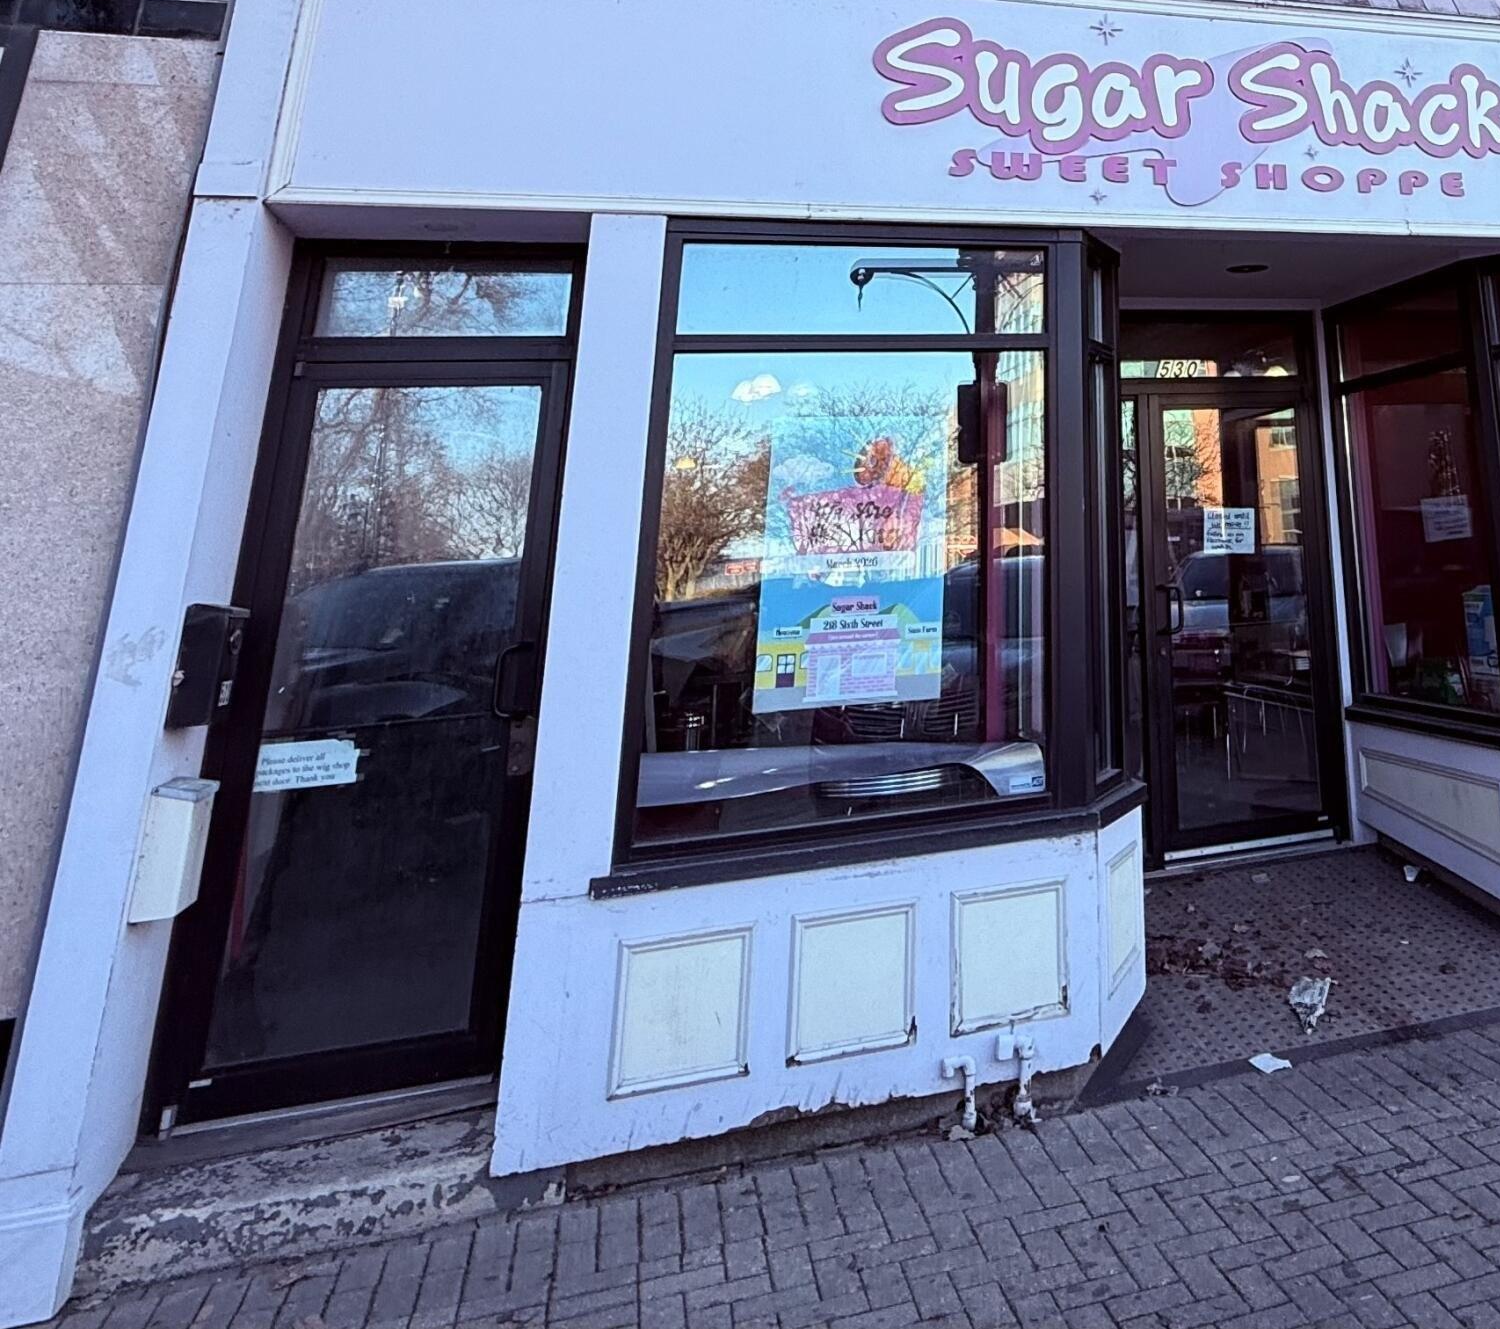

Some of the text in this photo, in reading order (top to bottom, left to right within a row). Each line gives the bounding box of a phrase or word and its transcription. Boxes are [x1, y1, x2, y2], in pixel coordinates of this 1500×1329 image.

[877, 22, 1210, 150] Sugar
[948, 149, 1465, 197] SWEET SHOPPE
[1160, 360, 1198, 378] 530
[832, 600, 878, 614] Sugar Shack
[840, 618, 859, 629] Sixth
[860, 617, 884, 628] Street
[262, 752, 326, 765] Please deliver all
[302, 764, 314, 772] the
[316, 763, 331, 773] wig
[332, 761, 351, 771] shop
[296, 774, 318, 785] Thank
[320, 773, 336, 782] you
